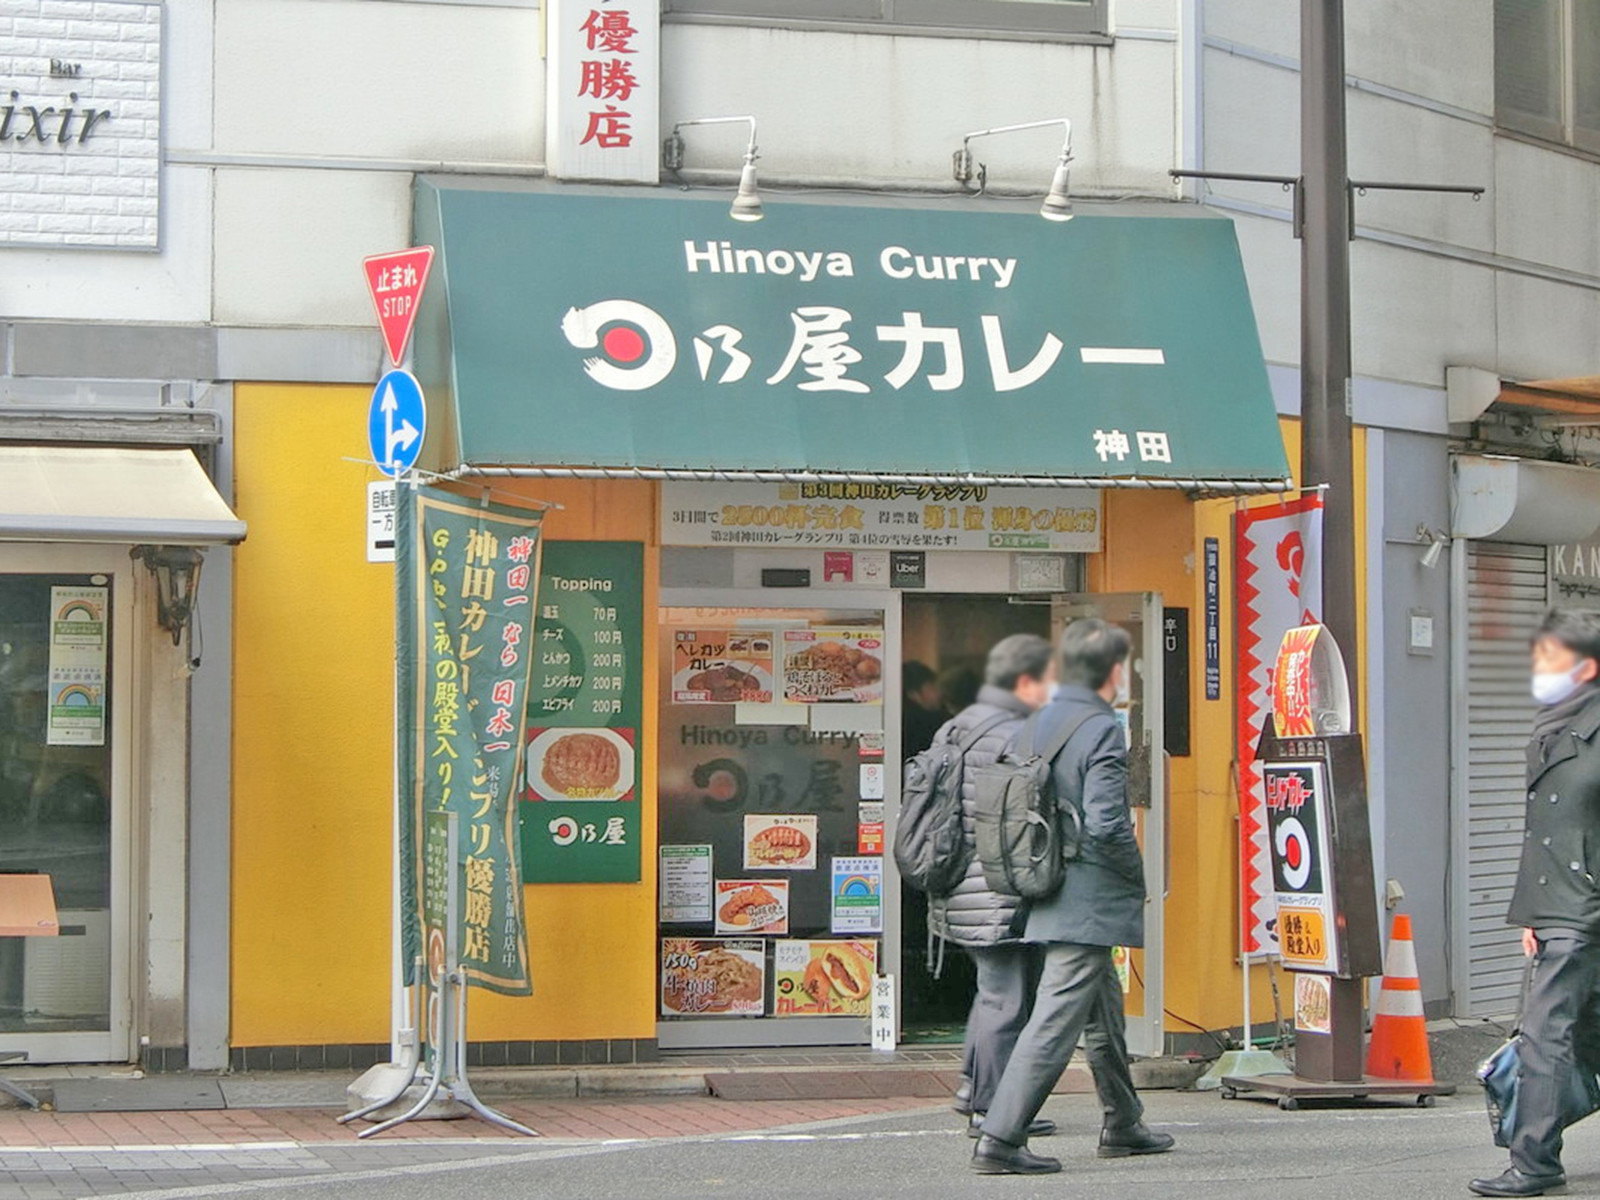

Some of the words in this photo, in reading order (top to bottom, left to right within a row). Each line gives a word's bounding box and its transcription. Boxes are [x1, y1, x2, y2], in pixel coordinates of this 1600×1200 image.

[49, 58, 82, 75] Bar
[577, 9, 641, 149] 優勝店
[684, 240, 854, 281] Hinoya
[880, 246, 1017, 289] Curry
[376, 262, 418, 293] 止まれ
[383, 295, 412, 318] STOP
[1093, 428, 1172, 464] 神田
[895, 563, 920, 574] Uber
[551, 576, 613, 593] Topping
[592, 607, 617, 622] 70円
[542, 628, 564, 642] チーズ
[593, 630, 623, 645] 100円
[542, 651, 571, 666] とんかつ
[592, 653, 623, 668] 200円
[690, 657, 726, 671] カレー
[592, 676, 623, 691] 200円
[592, 699, 622, 714] 200円
[681, 724, 768, 748] Hinoya
[783, 725, 860, 749] Curry
[666, 954, 698, 972] 150g
[876, 982, 891, 1043] 営業中
